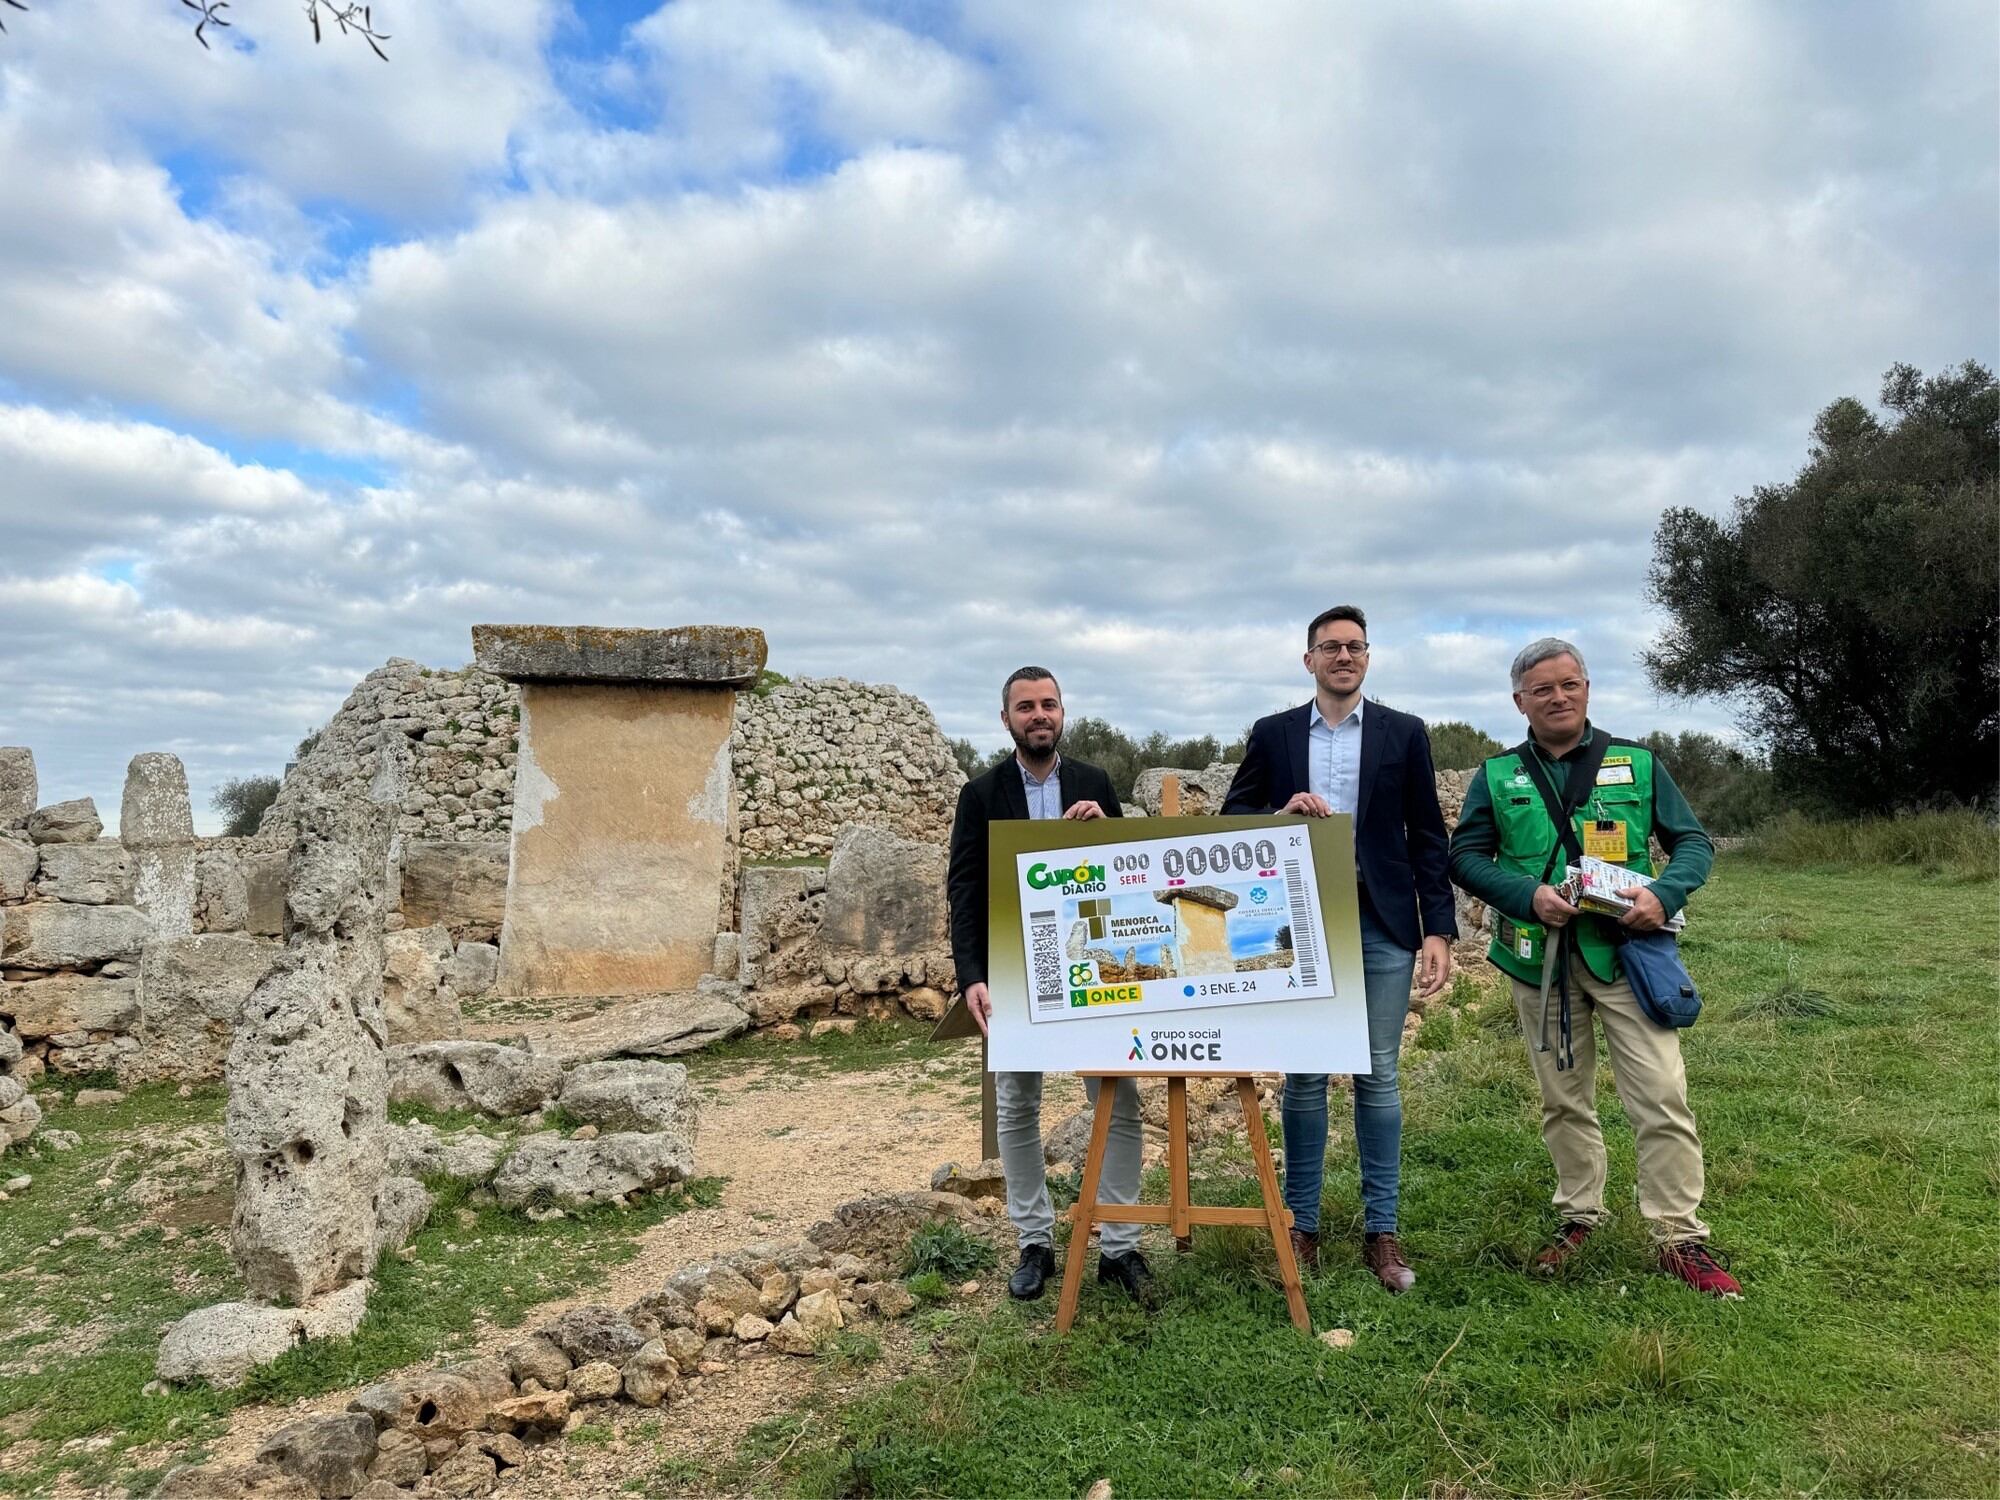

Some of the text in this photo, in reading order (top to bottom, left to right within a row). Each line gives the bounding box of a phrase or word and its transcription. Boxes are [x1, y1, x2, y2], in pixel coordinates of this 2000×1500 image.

[1289, 837, 1302, 847] 2€
[1113, 853, 1150, 873] 000
[1162, 839, 1277, 878] 00000
[1119, 874, 1147, 886] SERIE
[1111, 915, 1159, 928] MENORCA
[1112, 924, 1172, 938] TALAYÓTICA
[1068, 962, 1093, 988] 85
[1091, 987, 1139, 1003] ONCE
[1199, 980, 1257, 996] 3 ENE. 24
[1151, 1027, 1221, 1040] grupo social
[1151, 1042, 1222, 1061] ONCE
